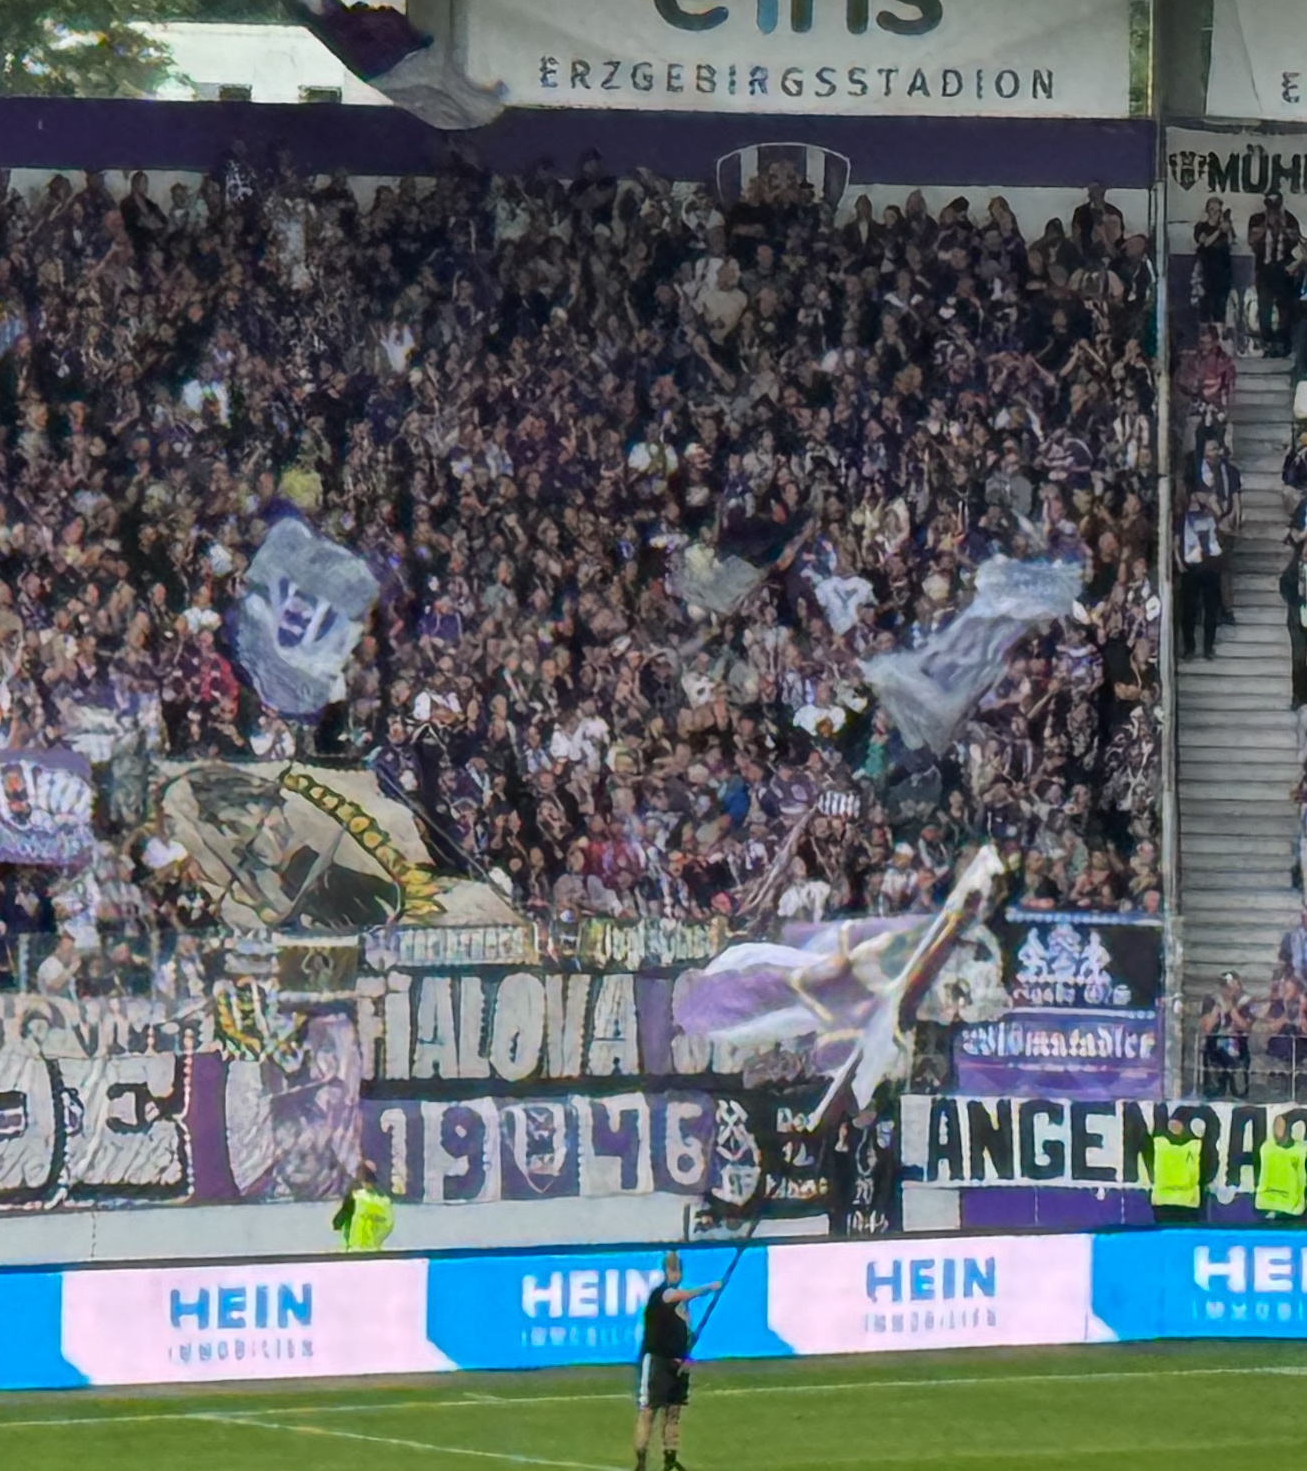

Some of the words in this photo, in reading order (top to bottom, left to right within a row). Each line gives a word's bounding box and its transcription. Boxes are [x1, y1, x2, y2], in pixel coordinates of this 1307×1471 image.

[539, 56, 1056, 100] ERZGEBIRGSSTADION
[1207, 143, 1307, 194] MÜH
[866, 1257, 996, 1304] HEIN
[170, 1283, 313, 1330] HEIN
